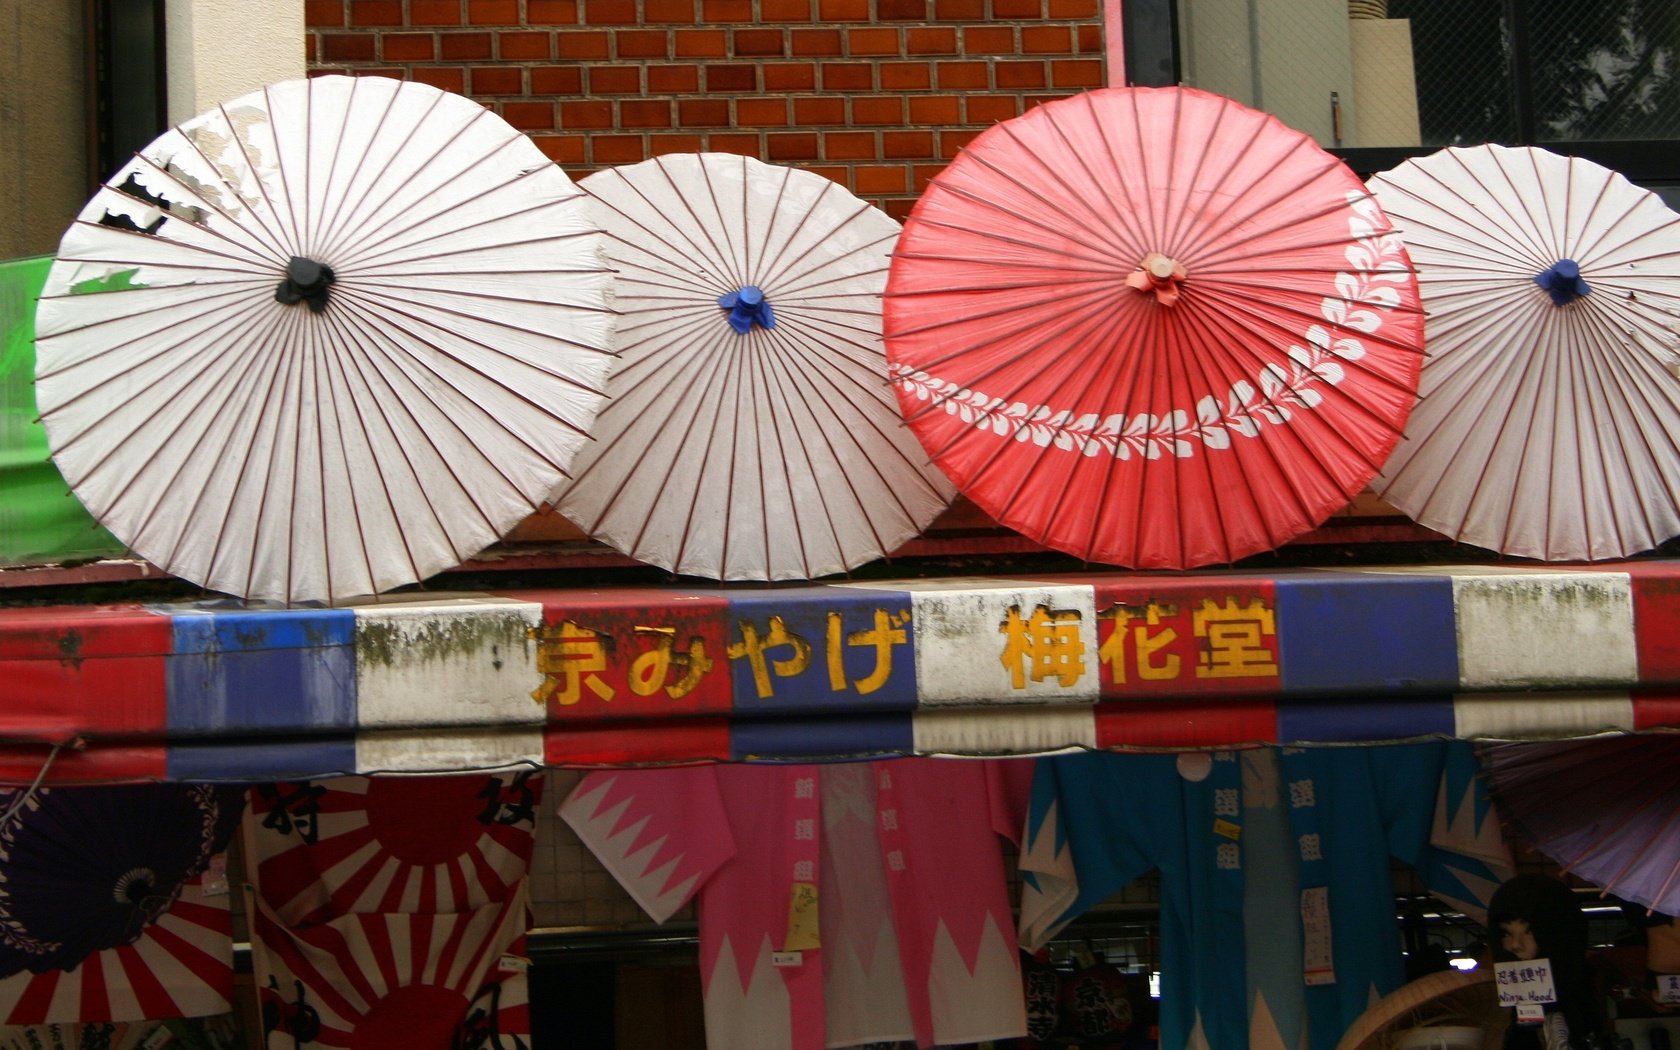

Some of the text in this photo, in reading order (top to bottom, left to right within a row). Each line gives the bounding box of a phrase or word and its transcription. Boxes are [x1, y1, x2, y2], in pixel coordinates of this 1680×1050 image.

[530, 596, 1279, 704] 京みやげ 梅花堂
[1528, 988, 1554, 1002] Hood
